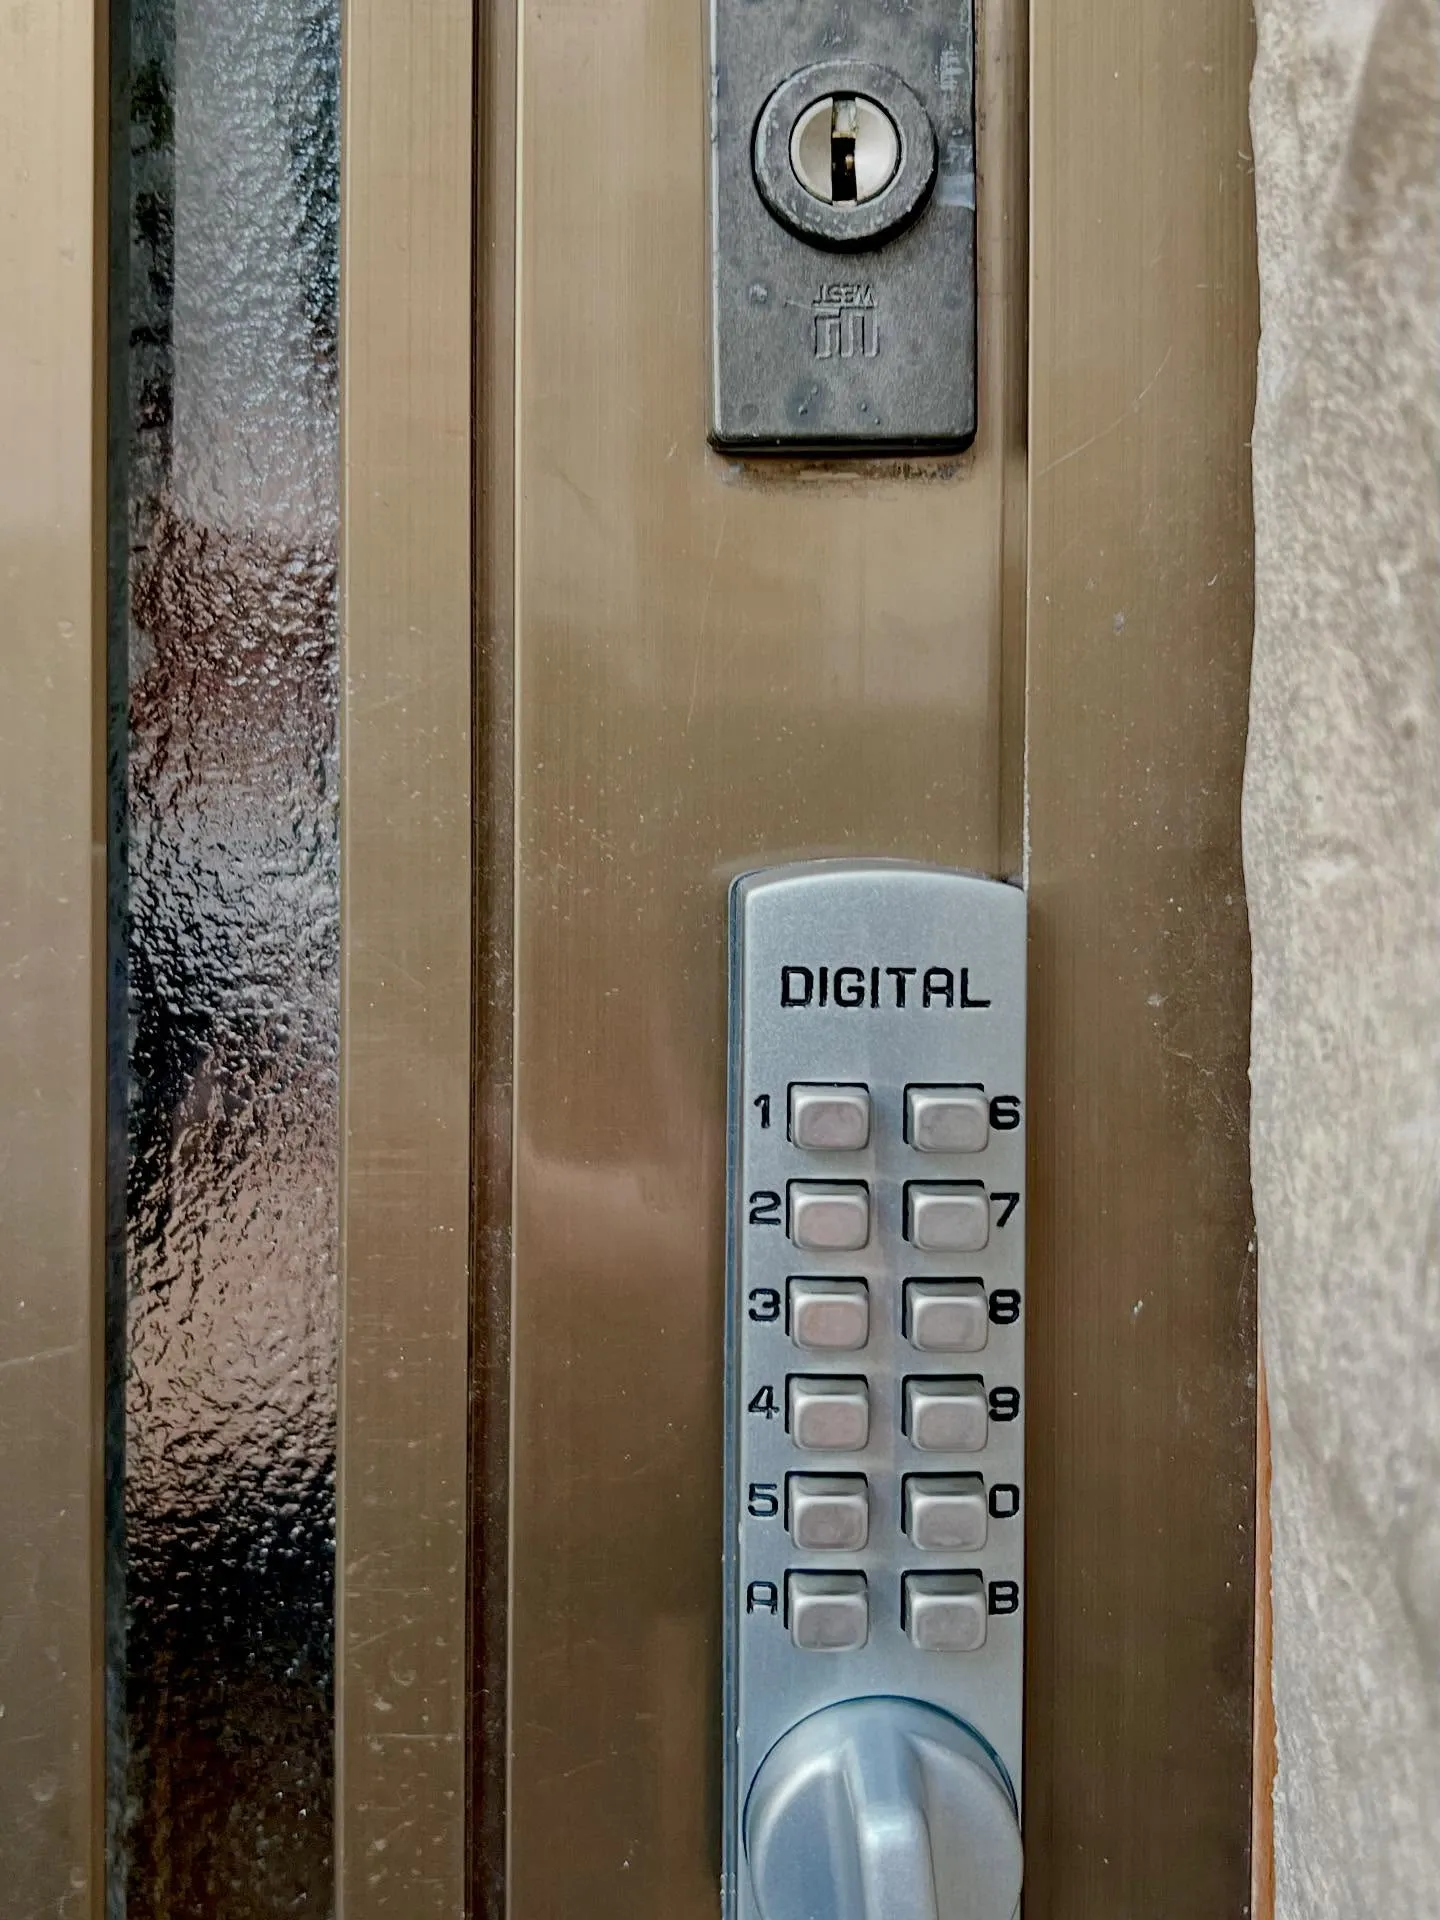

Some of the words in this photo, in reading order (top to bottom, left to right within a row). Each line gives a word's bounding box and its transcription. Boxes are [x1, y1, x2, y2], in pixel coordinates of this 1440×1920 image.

[812, 284, 876, 307] WEST
[781, 966, 991, 1008] DIGITAL
[754, 1094, 770, 1128] 1
[990, 1095, 1021, 1130] 6
[749, 1191, 781, 1225] 2
[990, 1192, 1020, 1228] 7
[749, 1288, 781, 1322] 3
[989, 1289, 1021, 1325] 8
[748, 1385, 779, 1419] 4
[989, 1386, 1020, 1422] 9
[748, 1483, 778, 1516] 5
[989, 1483, 1020, 1519] 0
[747, 1581, 778, 1615] A
[989, 1581, 1019, 1615] B
